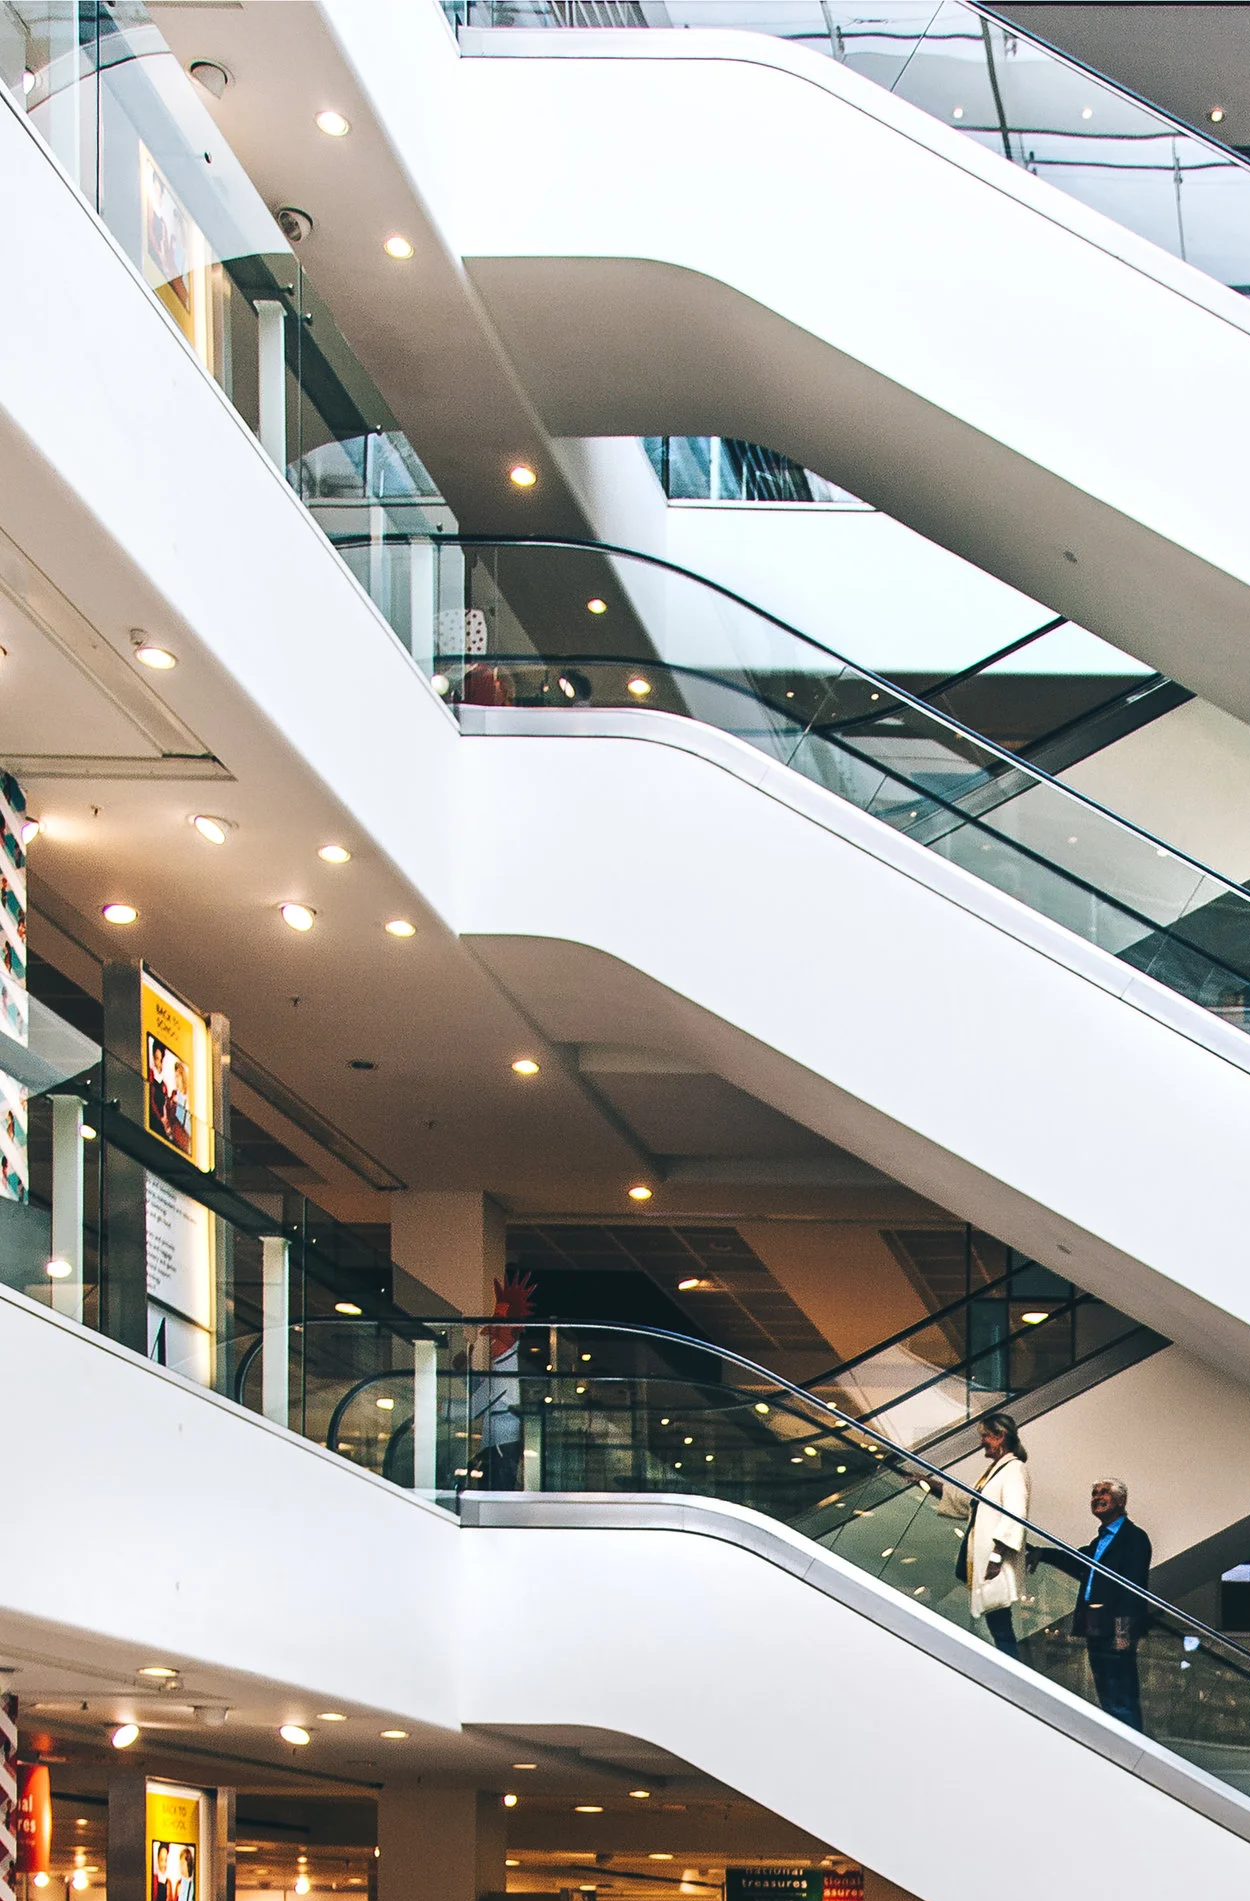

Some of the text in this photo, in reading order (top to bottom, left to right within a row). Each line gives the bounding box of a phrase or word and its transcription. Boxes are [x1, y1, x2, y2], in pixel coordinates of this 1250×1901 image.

[741, 1879, 807, 1889] treasures
[823, 1876, 862, 1886] tional
[823, 1887, 863, 1897] asures
